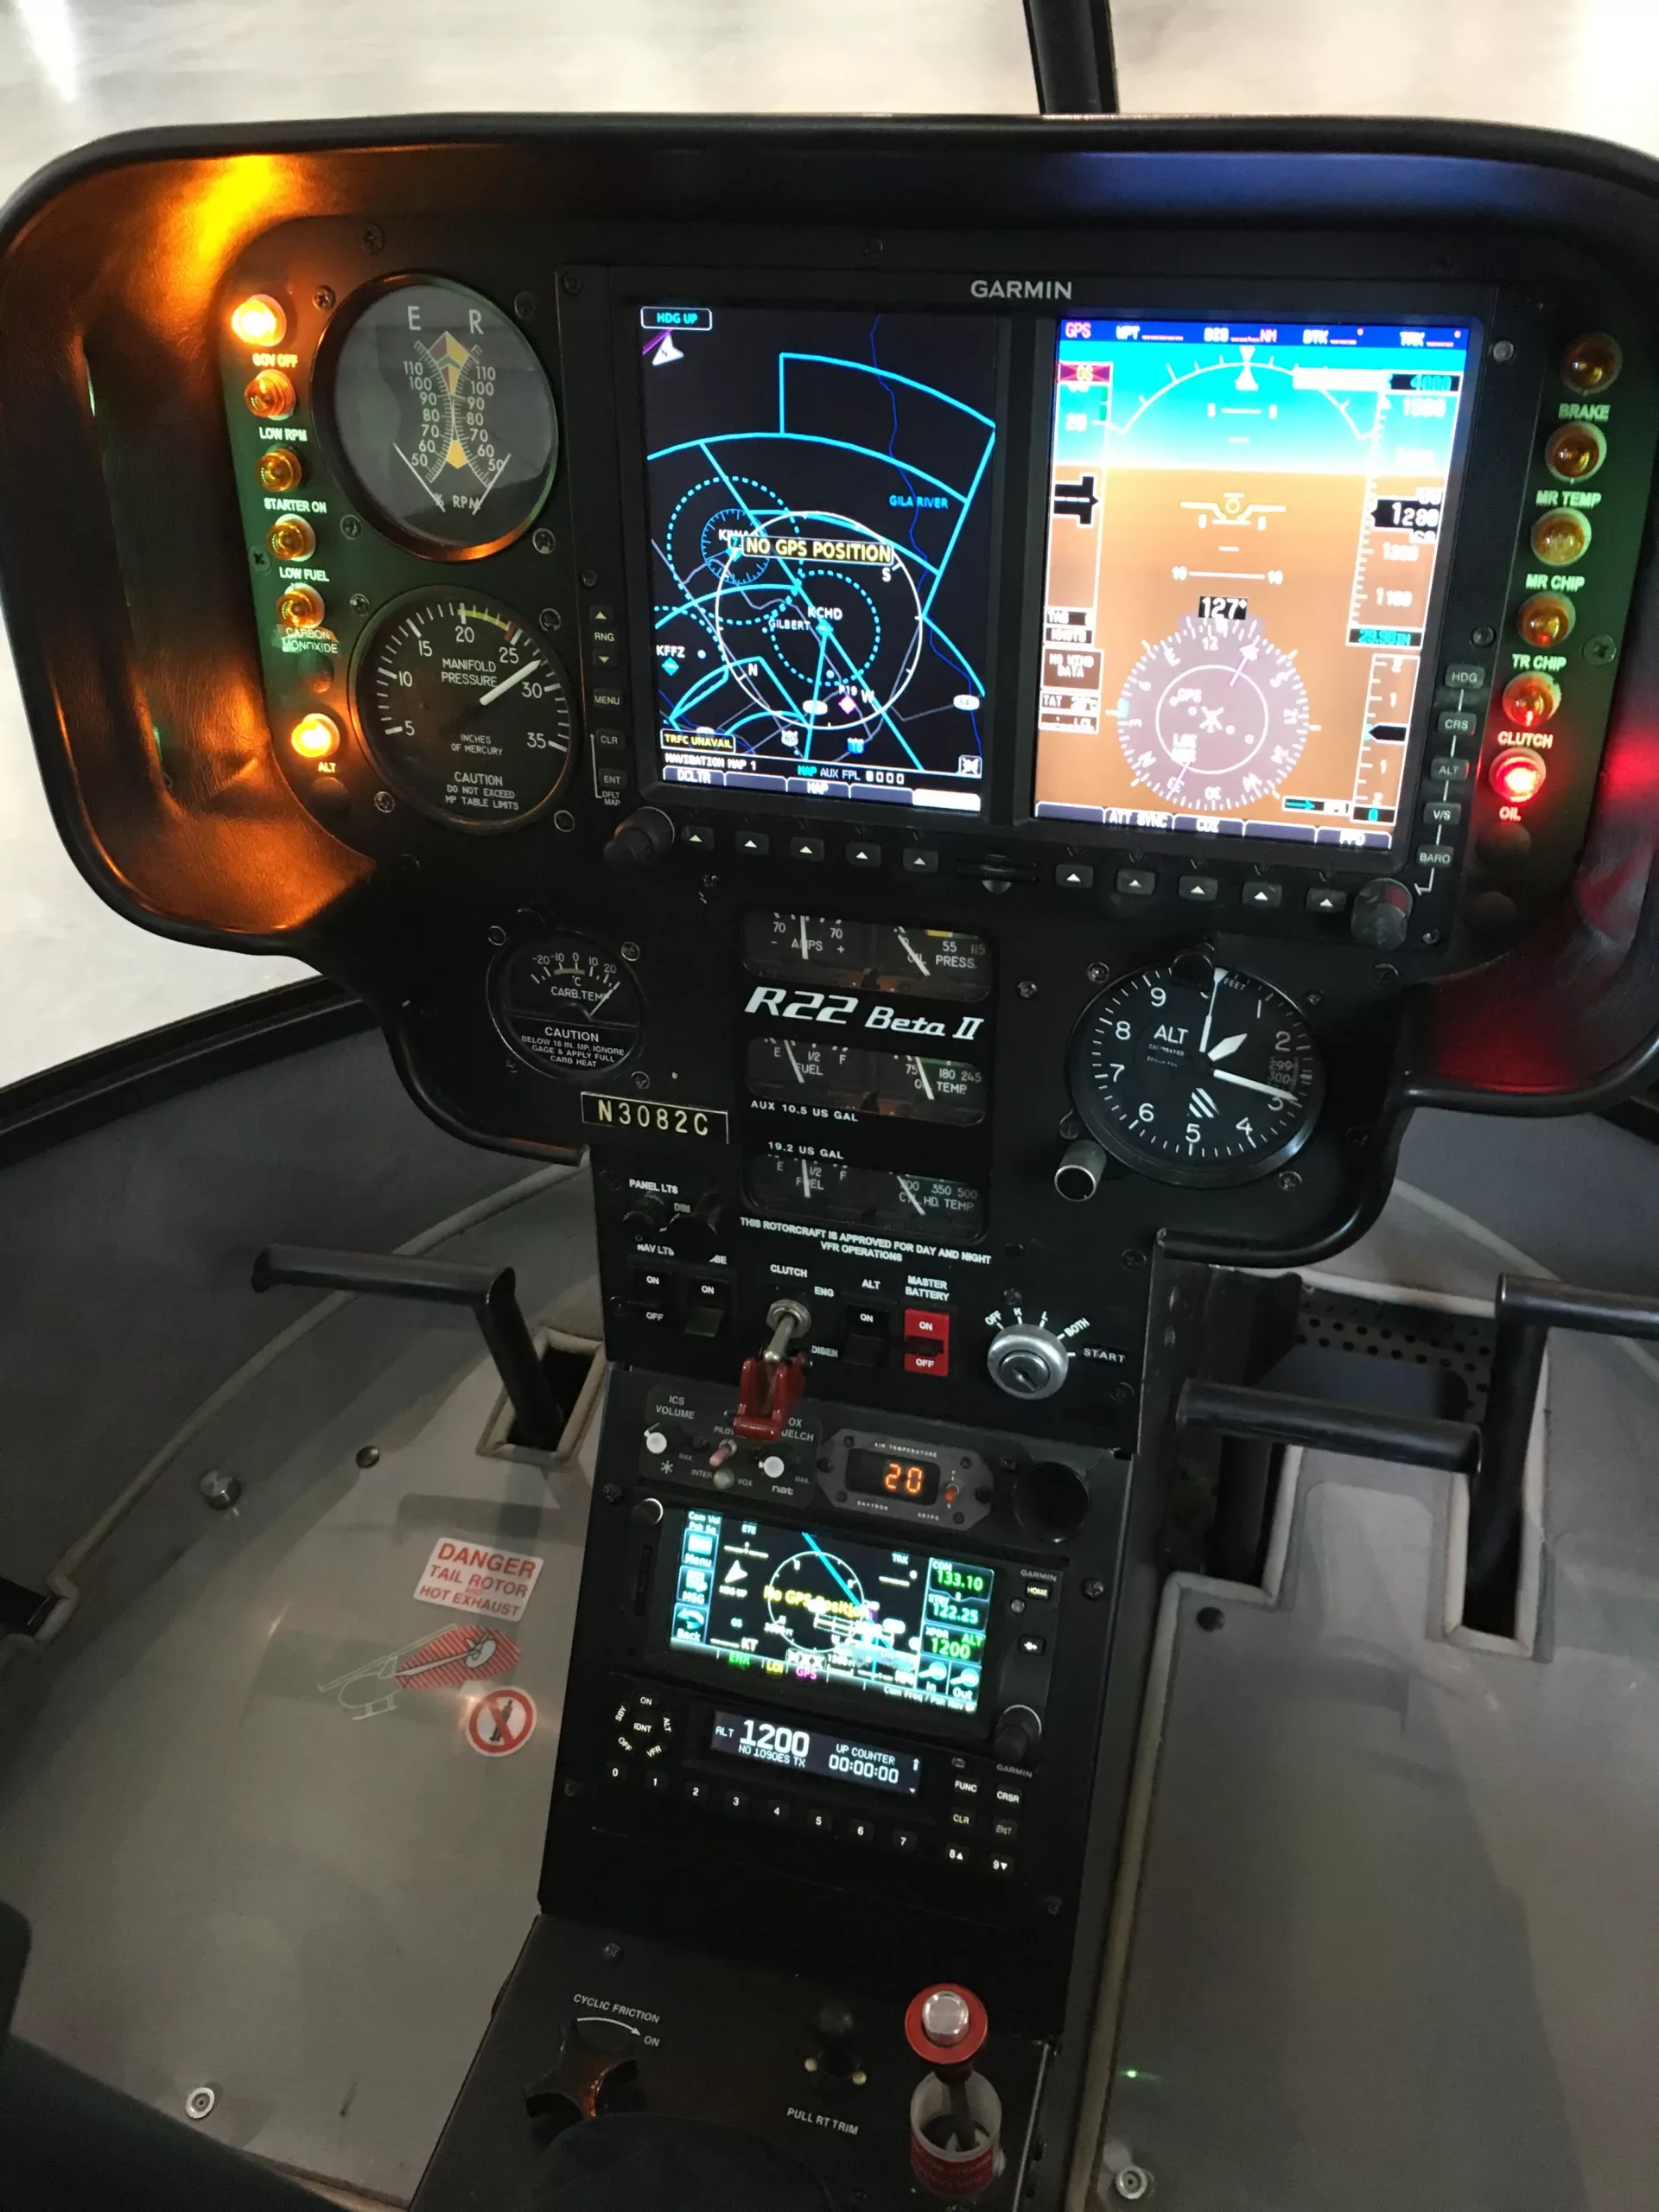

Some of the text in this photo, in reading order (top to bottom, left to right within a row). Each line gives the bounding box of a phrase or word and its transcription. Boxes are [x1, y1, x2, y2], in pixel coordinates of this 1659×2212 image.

[970, 280, 1072, 301] GARMIN
[408, 306, 422, 331] E
[468, 309, 484, 335] R
[657, 312, 698, 325] HDG UP
[1065, 322, 1090, 338] GPS
[1559, 404, 1610, 422] BRAKE
[259, 427, 307, 441] LOW RPM
[264, 497, 327, 512] STARTER ON
[889, 495, 949, 509] GILA RIVER
[1535, 490, 1601, 508] MR TEMP
[747, 537, 891, 562] NO GPS POSITION
[280, 567, 329, 582] LOW FUEL
[1526, 574, 1586, 592] MR CHIP
[808, 607, 843, 620] KCHD
[768, 619, 810, 631] GILBERT
[285, 627, 330, 639] CARBON
[455, 626, 474, 643] 20
[594, 632, 614, 642] RNG
[283, 639, 338, 653] MONOXIDE
[419, 640, 432, 657] 15
[657, 645, 685, 658] KFFZ
[499, 647, 519, 664] 25
[1513, 654, 1567, 671] TR CHIP
[442, 658, 496, 673] MANIFOLD
[398, 671, 413, 687] 10
[442, 671, 498, 688] PRESSURE
[1452, 671, 1477, 683] HDG
[522, 682, 543, 698] 30
[594, 695, 620, 706] MENU
[404, 721, 415, 735] 5
[1445, 719, 1468, 730] CRS
[461, 734, 492, 744] INCHES
[527, 733, 546, 748] 35
[601, 735, 618, 745] CLR
[664, 734, 732, 748] TRFC UNAVAIL
[1498, 731, 1553, 748] CLUTCH
[318, 761, 336, 772] ALT
[454, 772, 503, 786] CAUTION
[603, 775, 620, 785] ENT
[1433, 810, 1451, 821] V/S
[1499, 806, 1522, 821] OIL
[1420, 853, 1451, 863] BARO
[773, 921, 786, 933] 70
[830, 927, 843, 939] 70
[942, 940, 957, 953] 55
[589, 957, 598, 967] 10
[1150, 987, 1166, 1007] 9
[744, 986, 859, 1026] R22
[864, 1005, 946, 1037] Beta
[544, 1027, 599, 1043] CAUTION
[1116, 1020, 1131, 1040] 8
[1154, 1024, 1189, 1045] ALT
[1274, 1031, 1291, 1052] 2
[550, 1055, 597, 1067] CARB HEAT
[939, 1067, 956, 1080] 180
[961, 1071, 982, 1083] 245
[1109, 1063, 1125, 1083] 7
[598, 1099, 708, 1136] N3082C
[751, 1100, 858, 1122] AUX 10.5 US GAL
[1139, 1103, 1154, 1122] 6
[1185, 1123, 1201, 1143] 5
[1236, 1116, 1253, 1135] 4
[768, 1141, 844, 1160] 19.2 US GAL
[629, 1179, 678, 1194] PANEL LTS
[931, 1184, 951, 1196] 350
[741, 1217, 991, 1264] THIS ROTORCRAFT IS APPROVED FOR DAY AND NIGHT
[821, 1241, 902, 1262] VFR OPERATIONS
[770, 1263, 807, 1278] CLUTCH
[646, 1275, 659, 1285] ON
[862, 1279, 880, 1290] ALT
[907, 1275, 948, 1290] MASTER
[701, 1285, 715, 1294] ON
[814, 1287, 834, 1297] ENG
[906, 1287, 949, 1301] BATTERY
[860, 1313, 874, 1323] ON
[985, 1310, 1002, 1325] OFF
[919, 1321, 932, 1331] ON
[1065, 1318, 1090, 1337] BOTH
[916, 1358, 934, 1368] OFF
[1084, 1348, 1125, 1363] START
[670, 1395, 684, 1405] ICS
[656, 1405, 695, 1419] VOLUME
[885, 1462, 923, 1493] 20
[438, 1542, 537, 1580] DANGER
[685, 1554, 712, 1567] Menu
[892, 1553, 909, 1565] TRK
[430, 1564, 528, 1598] TAIL ROTOR
[937, 1569, 983, 1591] 133.10
[1020, 1568, 1057, 1582] GARMIN
[1027, 1586, 1048, 1597] HOME
[420, 1585, 521, 1618] HOT EXHAUST
[933, 1603, 978, 1624] 122.25
[677, 1628, 701, 1642] Back
[962, 1633, 983, 1646] ALT
[931, 1637, 970, 1659] 1200
[796, 1666, 817, 1680] GPS
[640, 1696, 652, 1706] ON
[953, 1687, 972, 1700] Out
[615, 1705, 626, 1722] SBY
[633, 1722, 652, 1733] IDNT
[663, 1717, 671, 1732] ALT
[618, 1737, 632, 1752] OFF
[715, 1719, 810, 1758] ALT 1200
[646, 1745, 662, 1758] VFR
[738, 1744, 806, 1768] NO 1090ES TX
[836, 1743, 895, 1766] UP COUNTER
[829, 1754, 899, 1784] 00:00:00
[996, 1764, 1033, 1778] GARMIN
[955, 1780, 977, 1793] FUNC
[996, 1790, 1020, 1804] CRSR
[953, 1814, 969, 1825] CLR
[573, 1993, 660, 2024] CYCLIC FRICTION
[644, 2035, 660, 2047] ON
[787, 2107, 859, 2136] PULL RT TRIM
